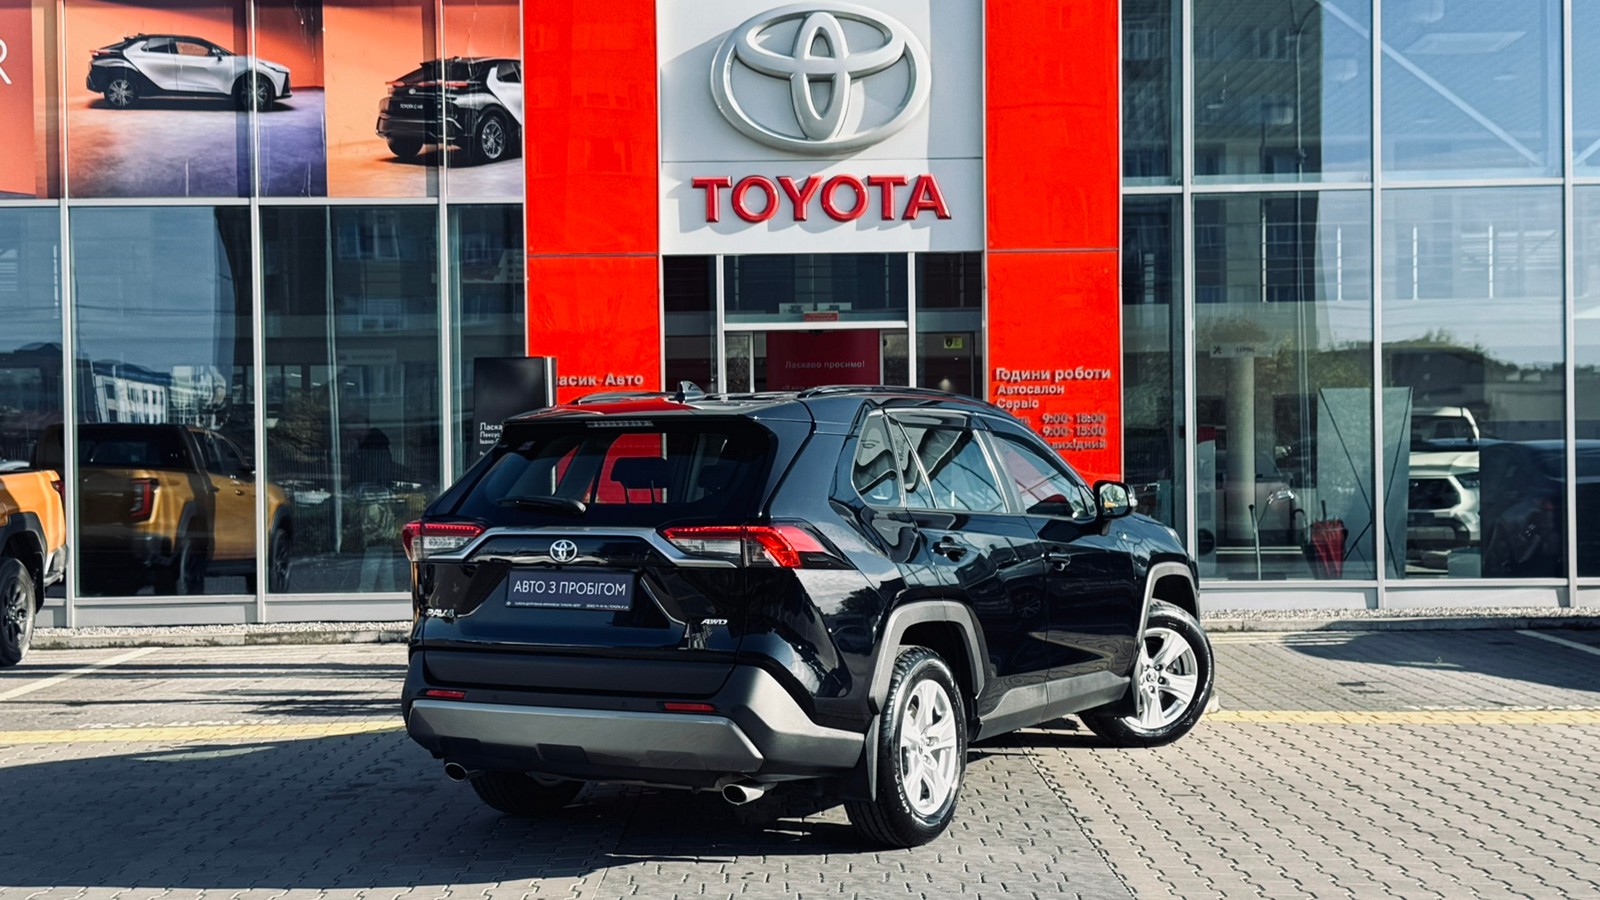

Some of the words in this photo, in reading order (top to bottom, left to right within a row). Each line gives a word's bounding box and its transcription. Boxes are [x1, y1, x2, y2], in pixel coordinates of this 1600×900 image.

[691, 174, 952, 223] TOYOTA
[996, 367, 1050, 382] Години
[1055, 366, 1111, 382] роботи
[997, 384, 1065, 395] Автосалон
[996, 397, 1039, 410] Сервіс
[1042, 413, 1068, 424] 9:00
[1042, 425, 1068, 436] 9:00
[513, 580, 546, 594] АВТО
[548, 581, 557, 594] З
[559, 581, 626, 596] ПРОБІГОМ
